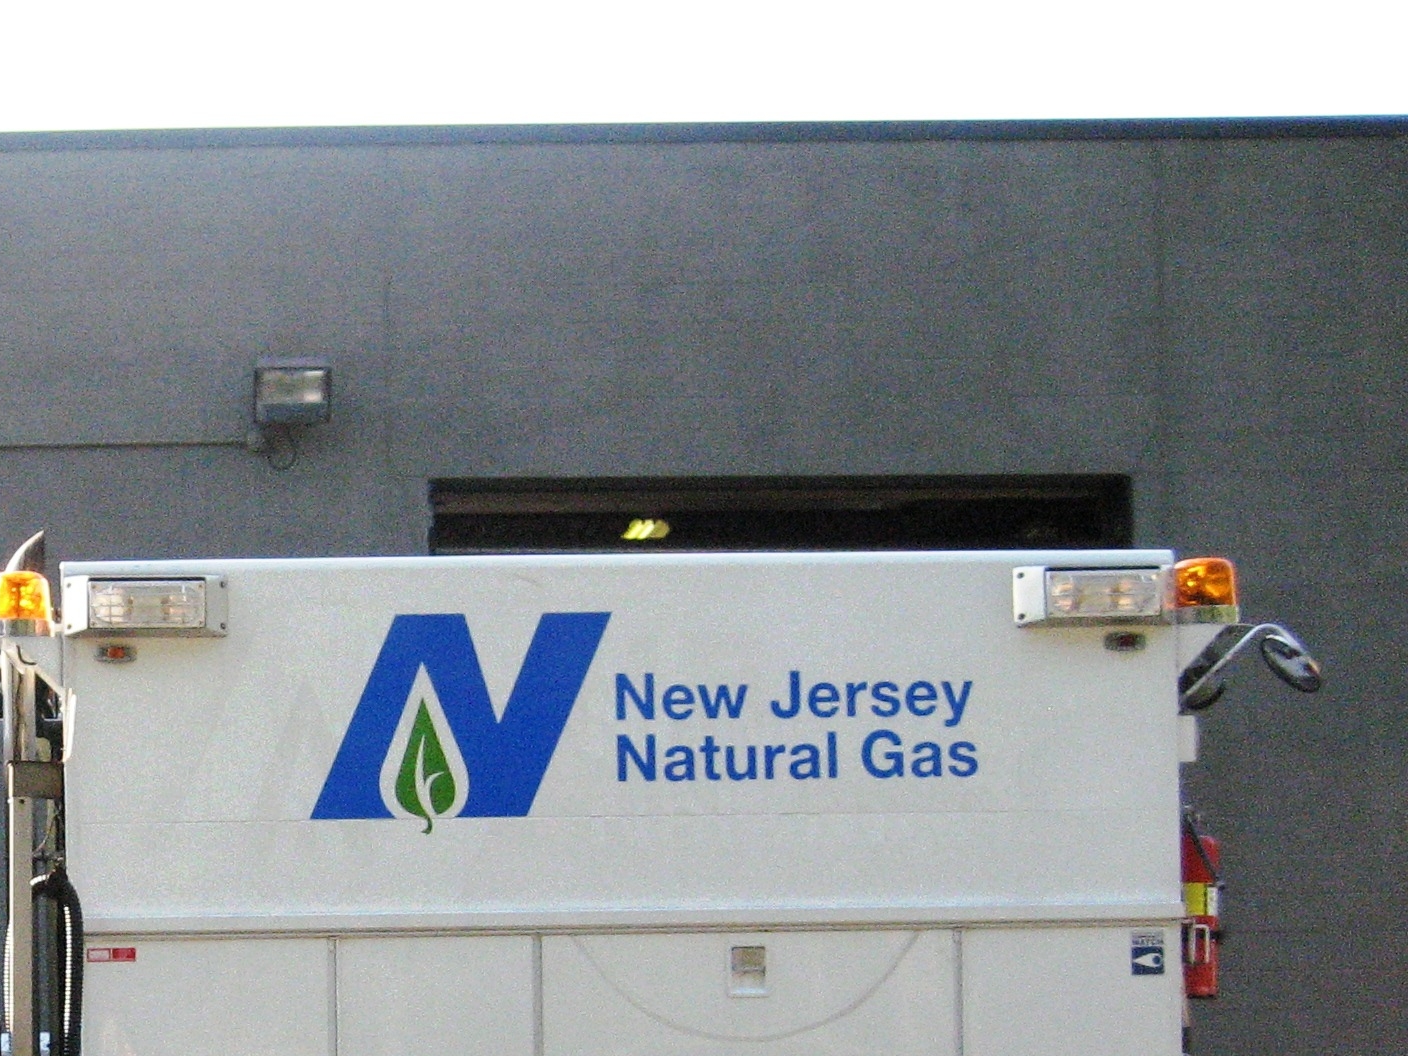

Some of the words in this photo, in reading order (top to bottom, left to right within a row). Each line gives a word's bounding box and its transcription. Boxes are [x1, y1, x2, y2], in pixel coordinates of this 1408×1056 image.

[616, 672, 748, 721] New
[769, 670, 973, 728] Jersey
[617, 731, 839, 782] Natural
[861, 729, 979, 779] Gas
